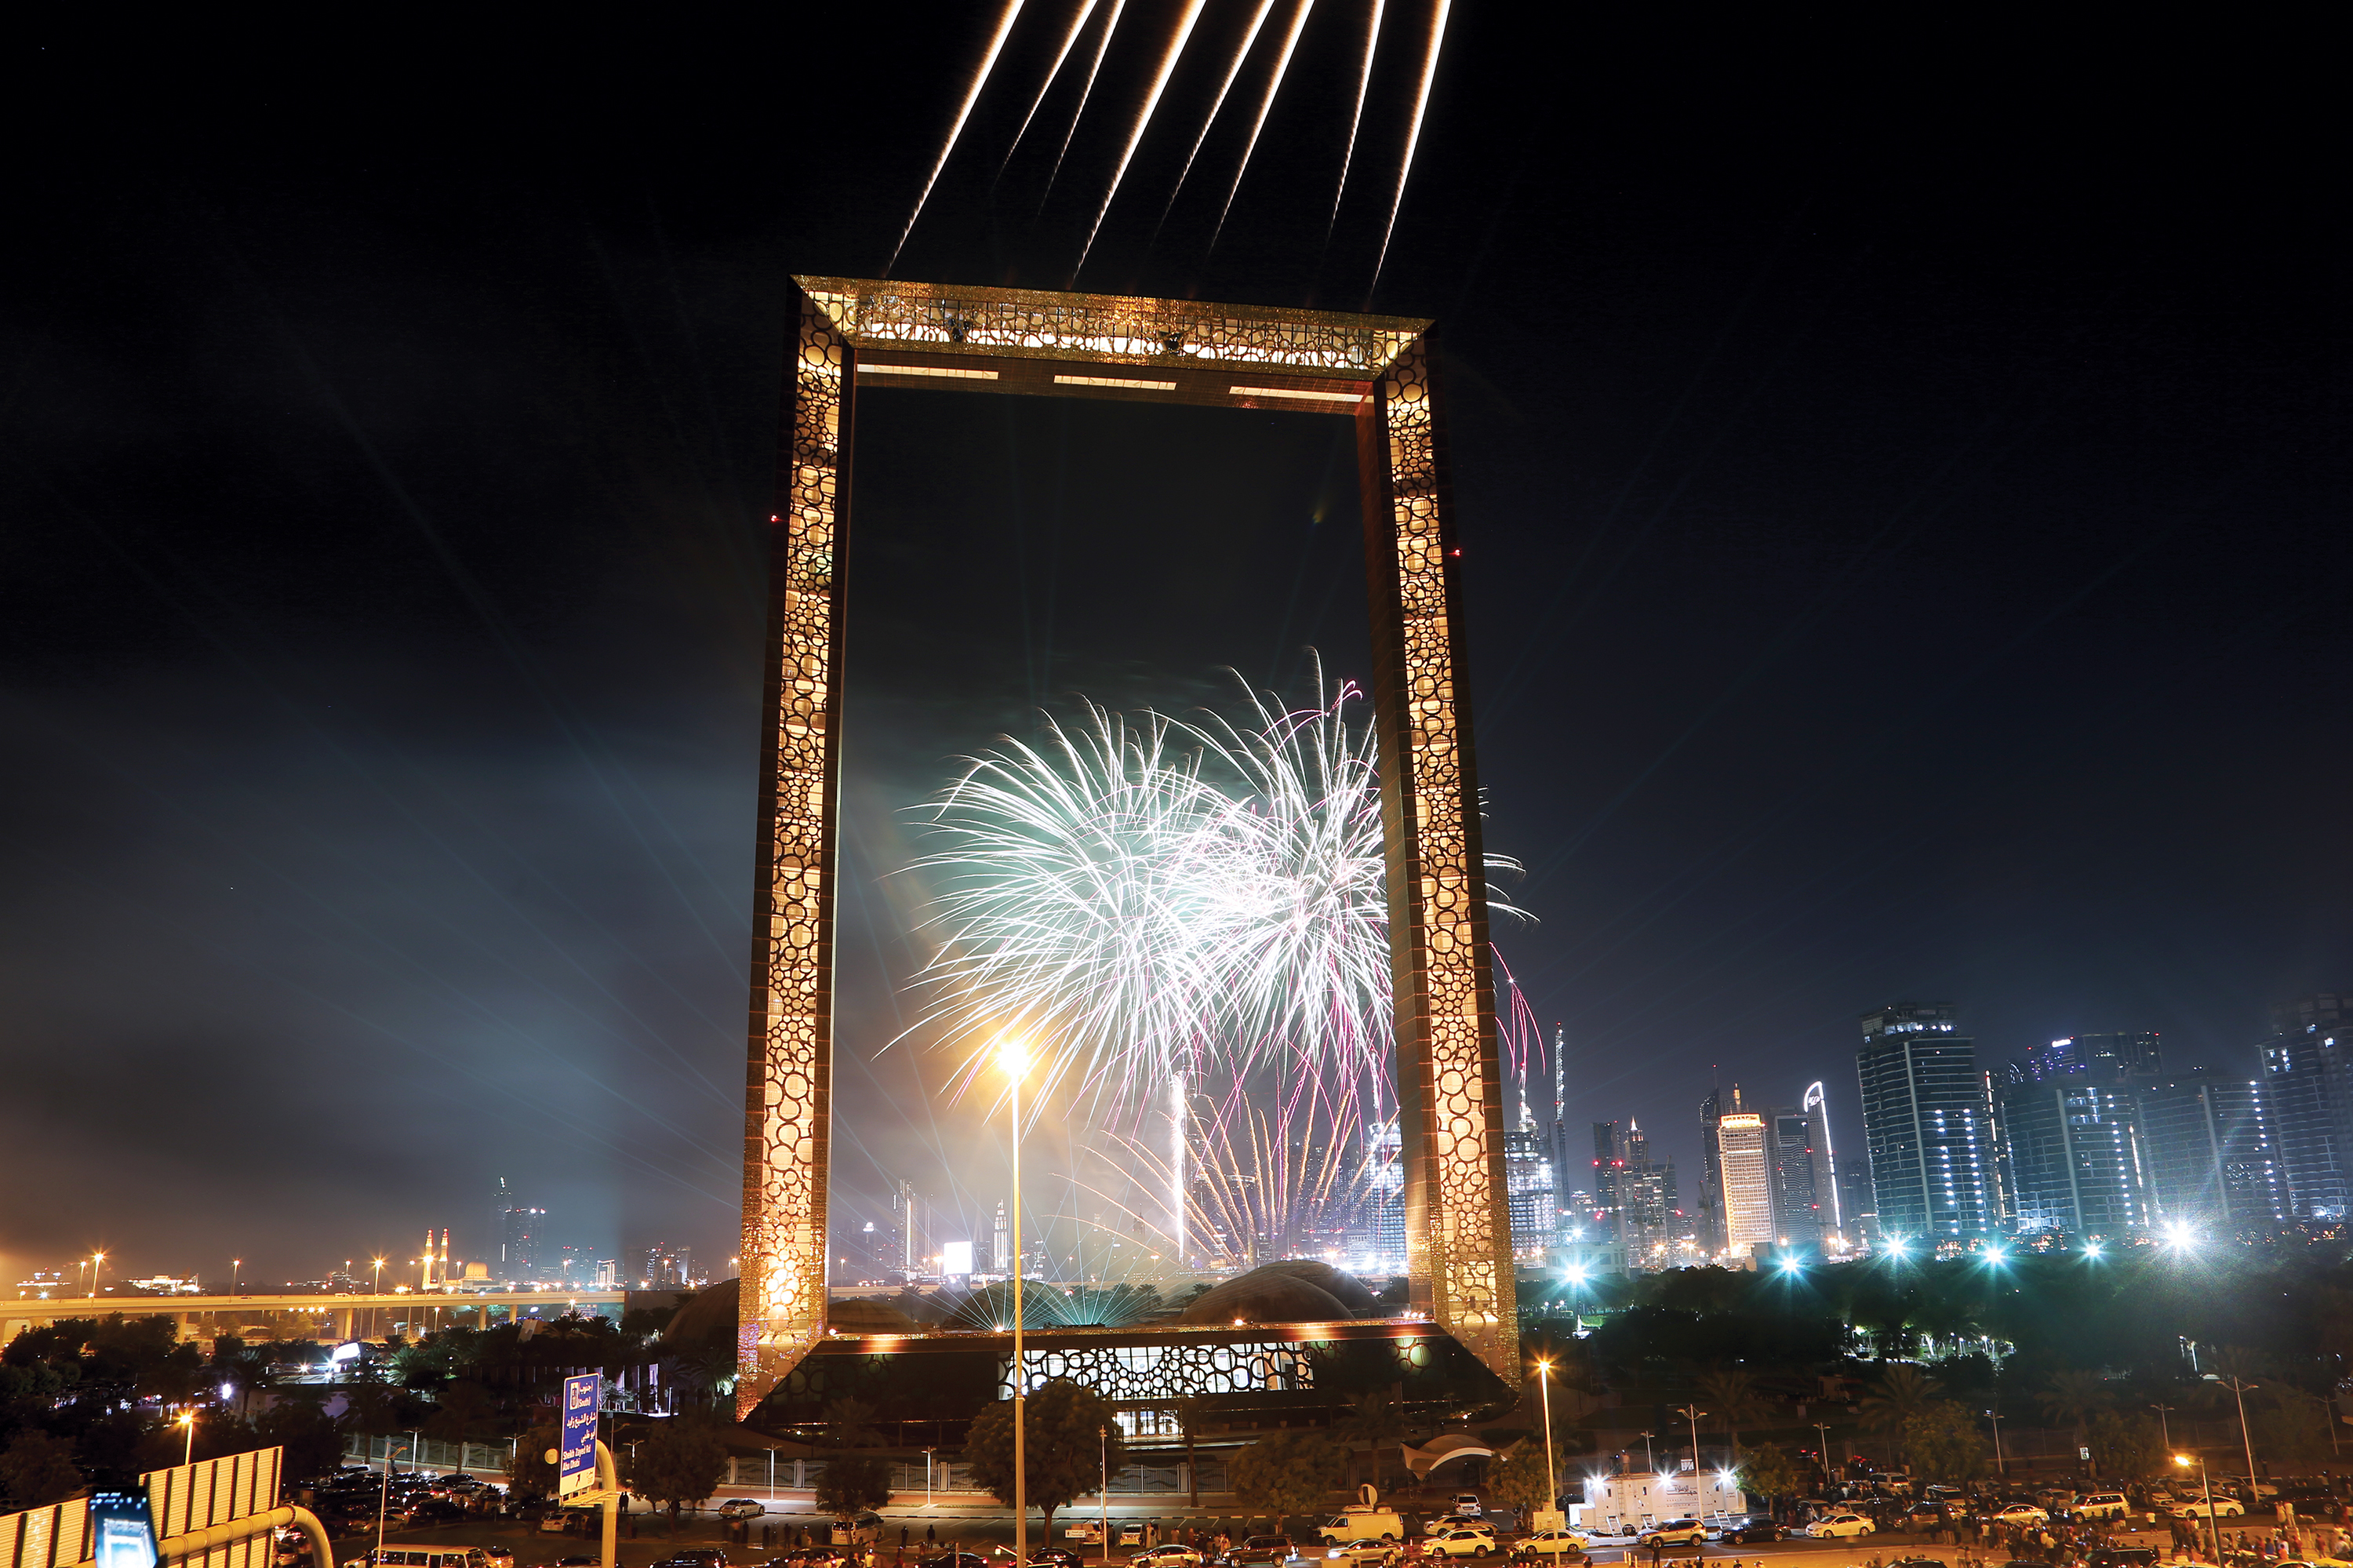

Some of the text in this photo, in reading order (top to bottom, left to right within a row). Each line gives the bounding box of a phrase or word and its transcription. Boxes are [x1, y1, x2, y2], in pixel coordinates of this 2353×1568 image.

[575, 1413, 586, 1429] الشيخ
[585, 1411, 596, 1426] شارع
[563, 1444, 591, 1460] Sheikh Zayed Rd
[570, 1457, 580, 1469] Dhabi
